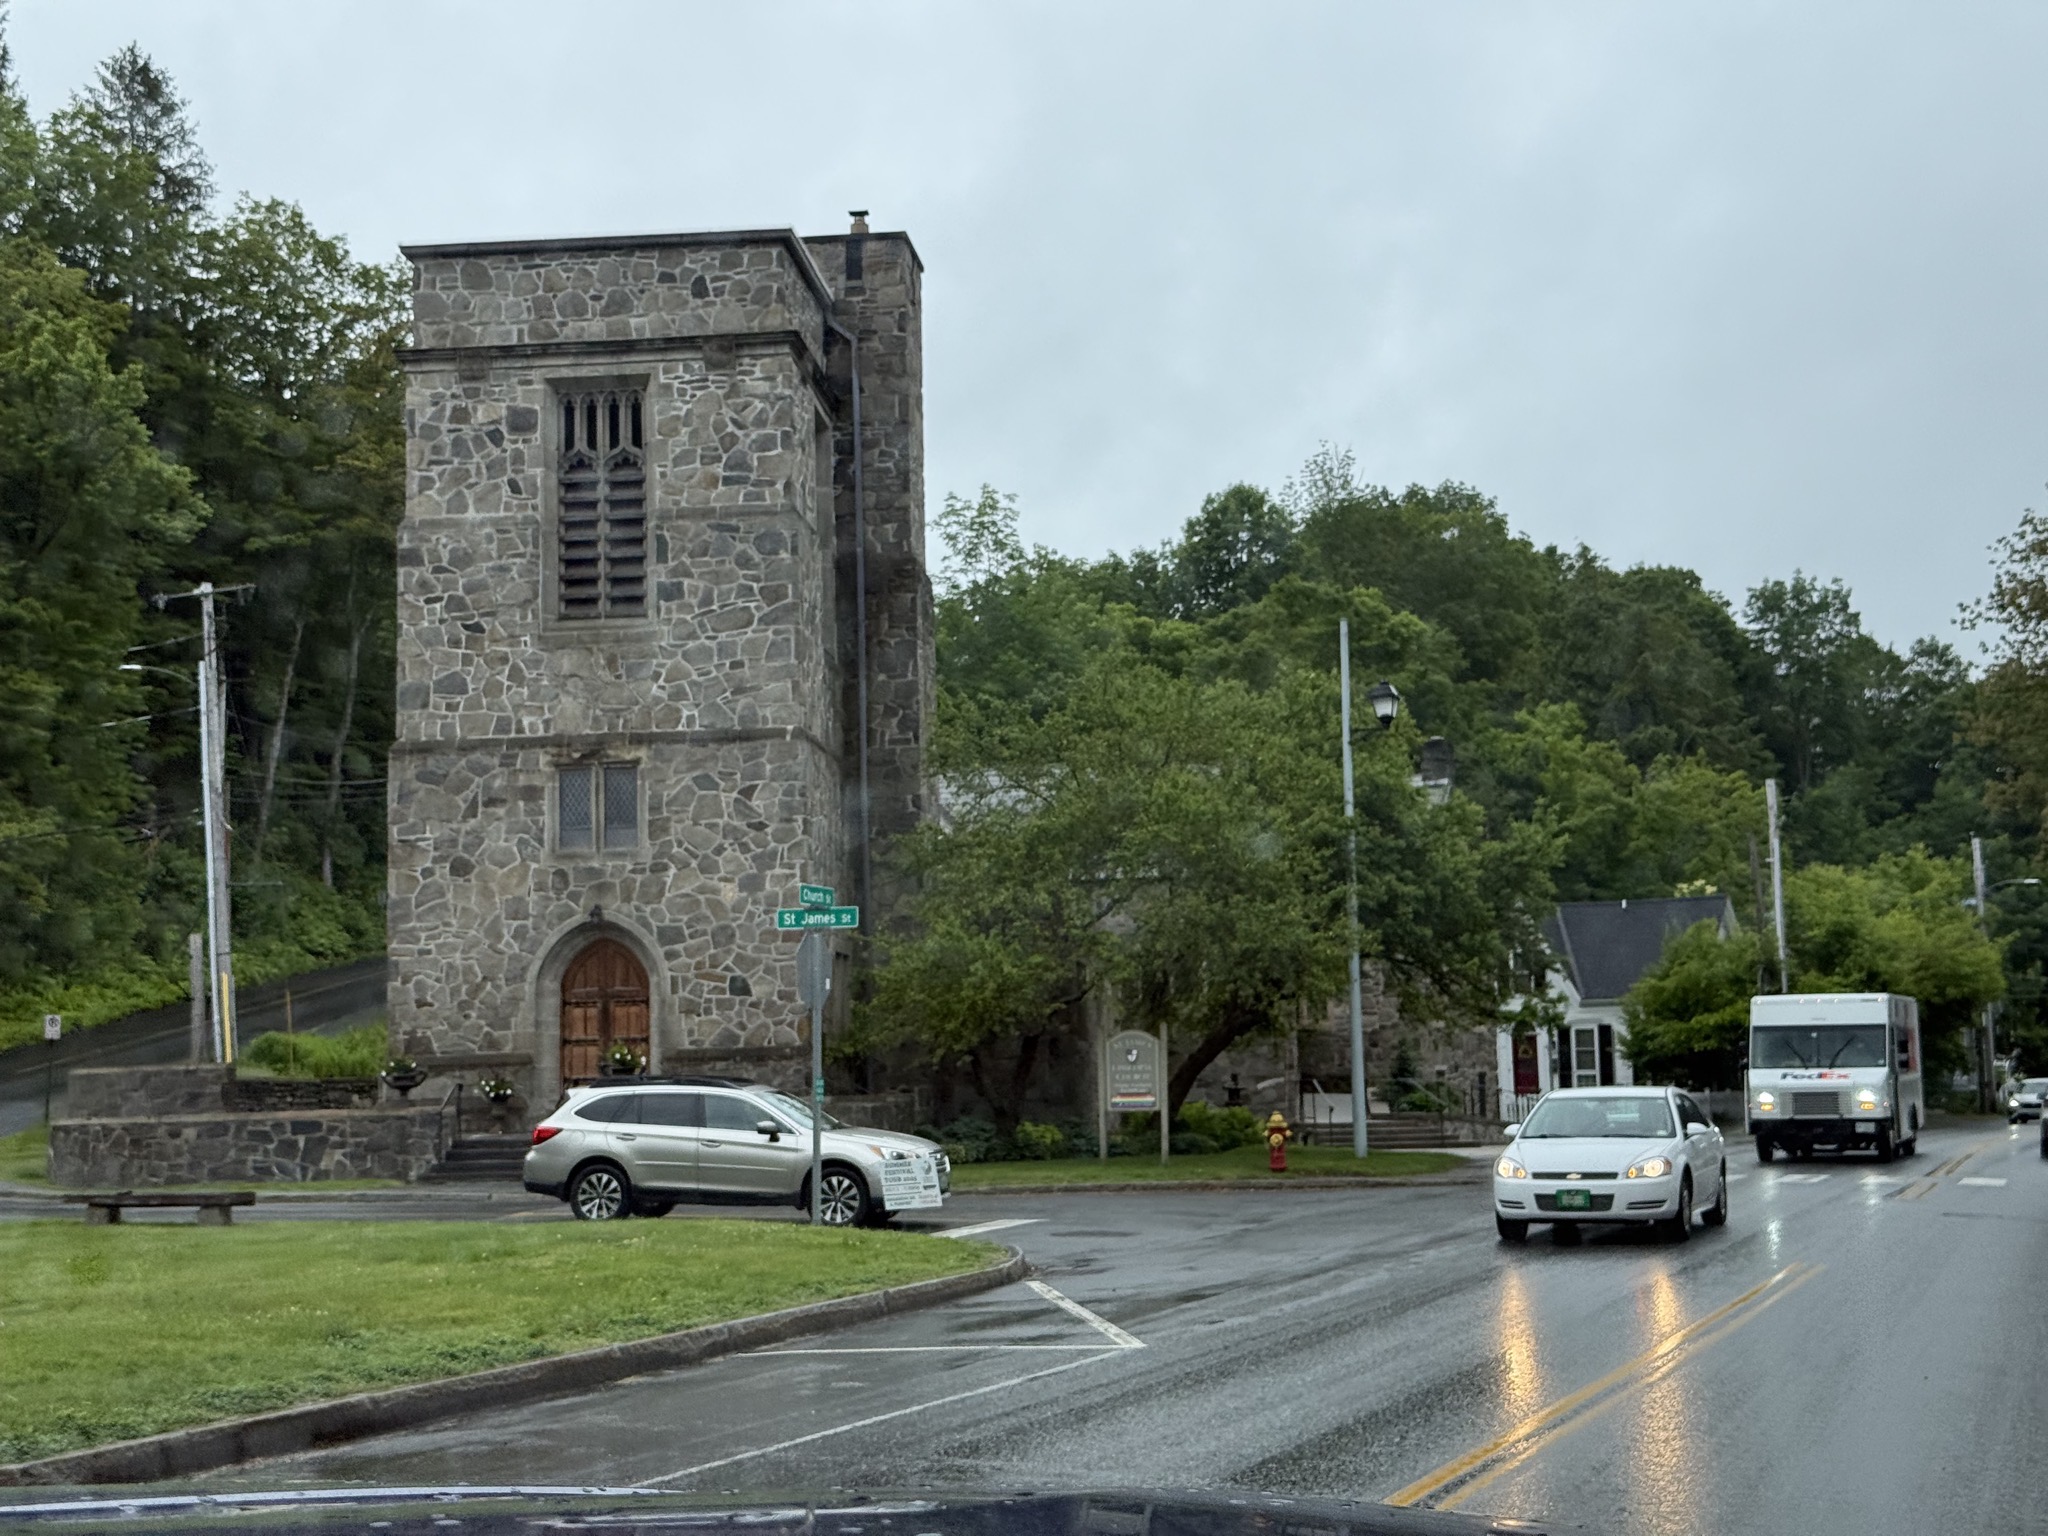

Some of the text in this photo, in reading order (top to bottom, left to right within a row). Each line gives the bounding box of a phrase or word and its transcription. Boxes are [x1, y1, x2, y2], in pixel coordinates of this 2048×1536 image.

[803, 888, 823, 902] Church
[783, 912, 851, 925] St James St
[1781, 1071, 1851, 1080] FedEx
